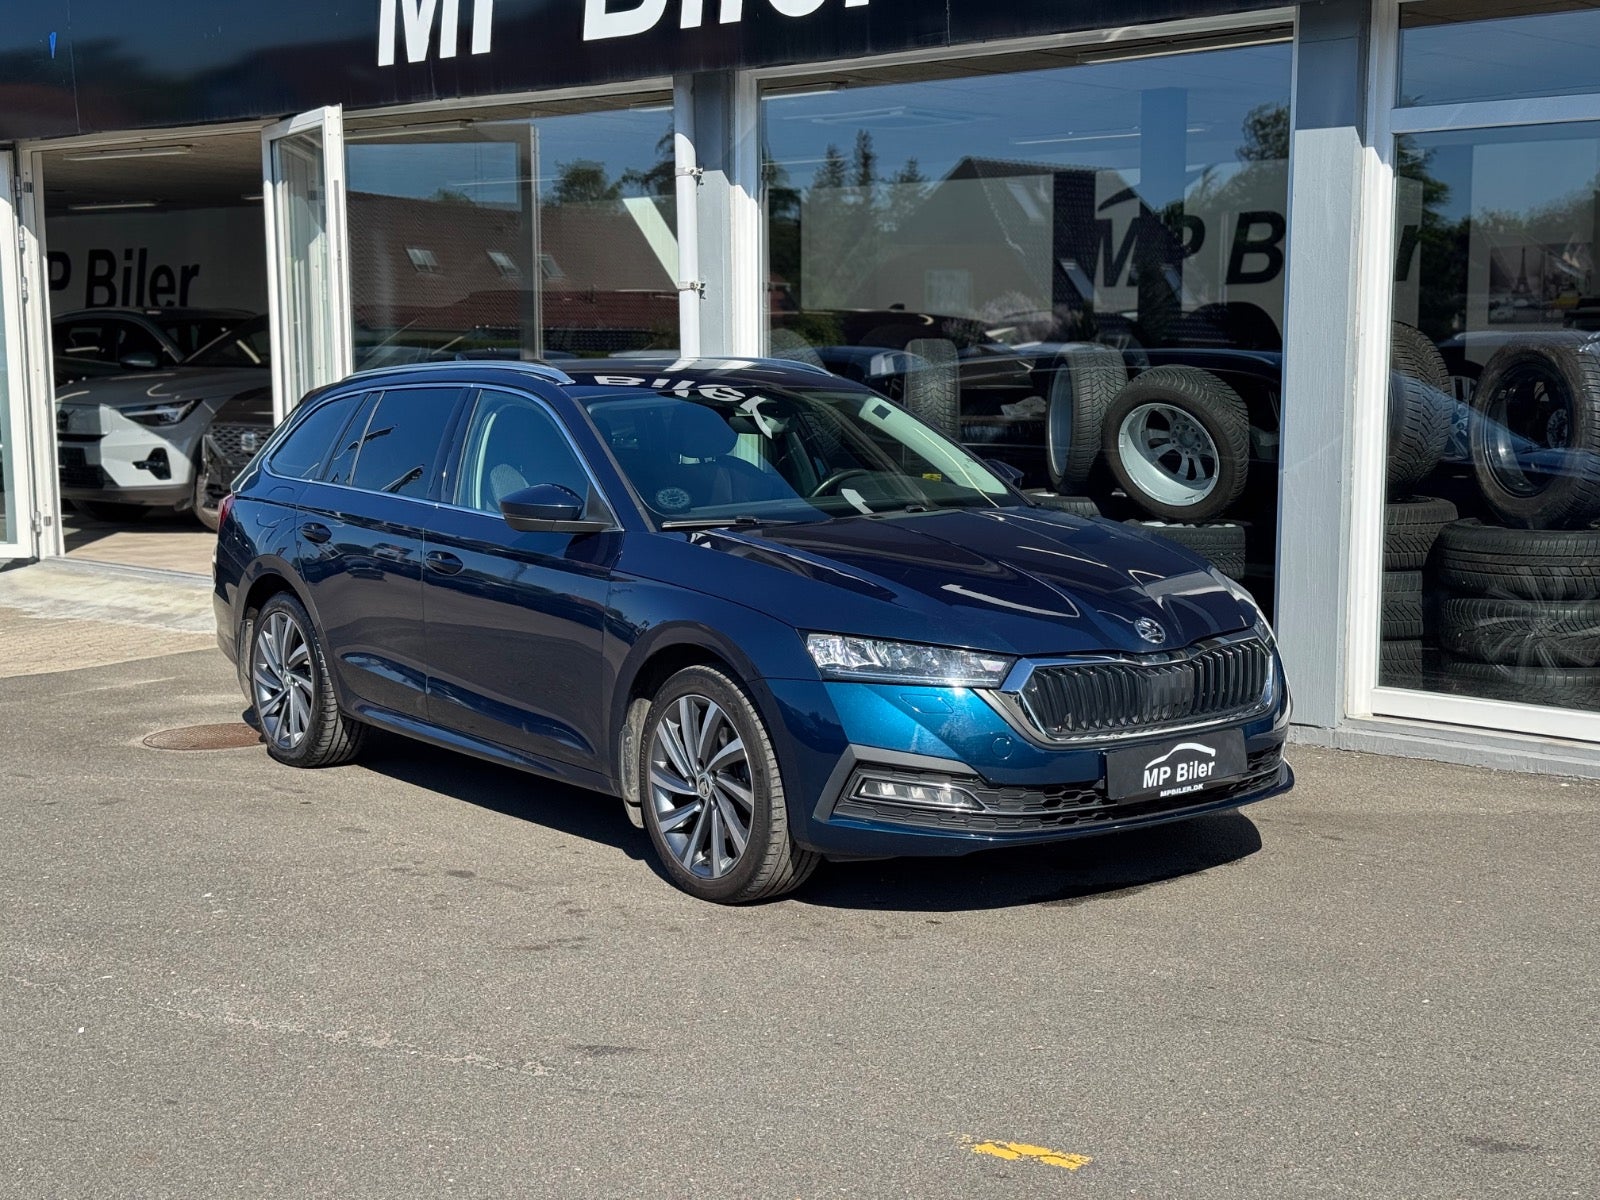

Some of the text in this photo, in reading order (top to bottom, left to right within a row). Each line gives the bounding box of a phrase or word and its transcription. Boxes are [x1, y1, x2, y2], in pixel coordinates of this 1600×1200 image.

[86, 247, 200, 308] Biler
[1143, 760, 1216, 788] MP Biler
[1160, 783, 1204, 797] MPBILER.DK
